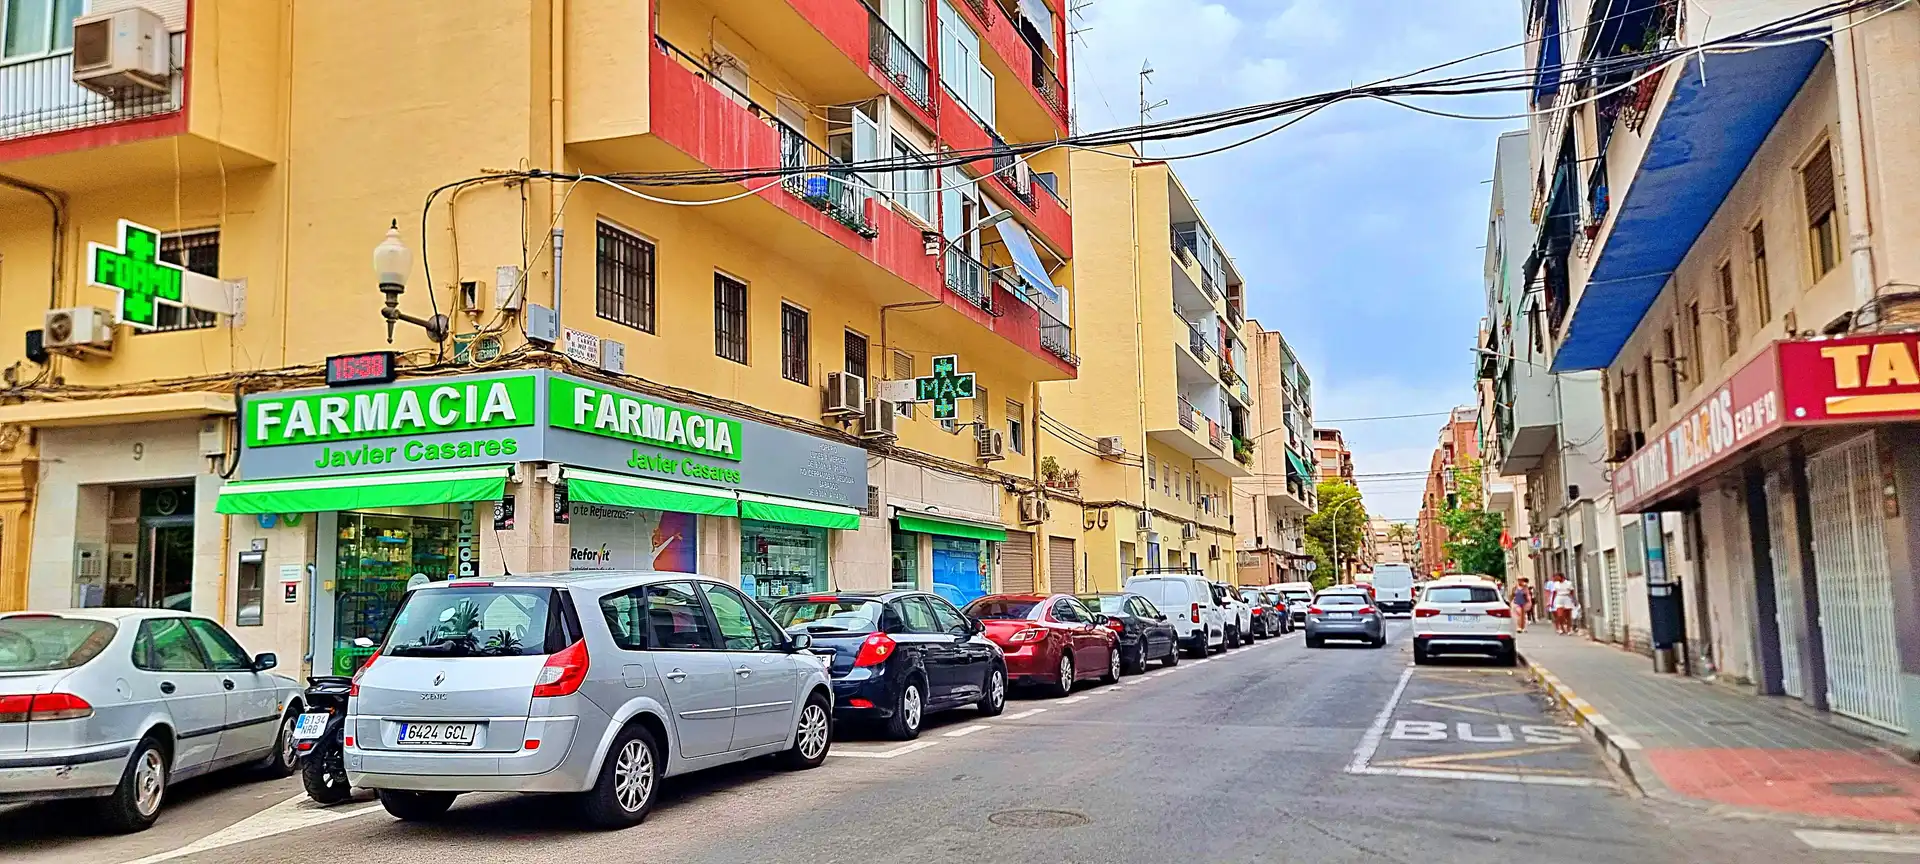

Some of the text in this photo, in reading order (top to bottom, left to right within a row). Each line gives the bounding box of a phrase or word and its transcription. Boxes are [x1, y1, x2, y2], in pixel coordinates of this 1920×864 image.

[1820, 341, 1920, 389] TA
[920, 376, 972, 400] MAC
[256, 381, 517, 441] FARMACIA
[574, 387, 733, 455] FARMACIA
[132, 442, 144, 461] 9
[315, 437, 518, 468] Javier Casares
[627, 448, 741, 484] Javier Casares
[573, 506, 579, 515] o
[580, 504, 588, 516] te
[408, 724, 468, 740] 6424 GCL
[1390, 719, 1582, 745] BUS
